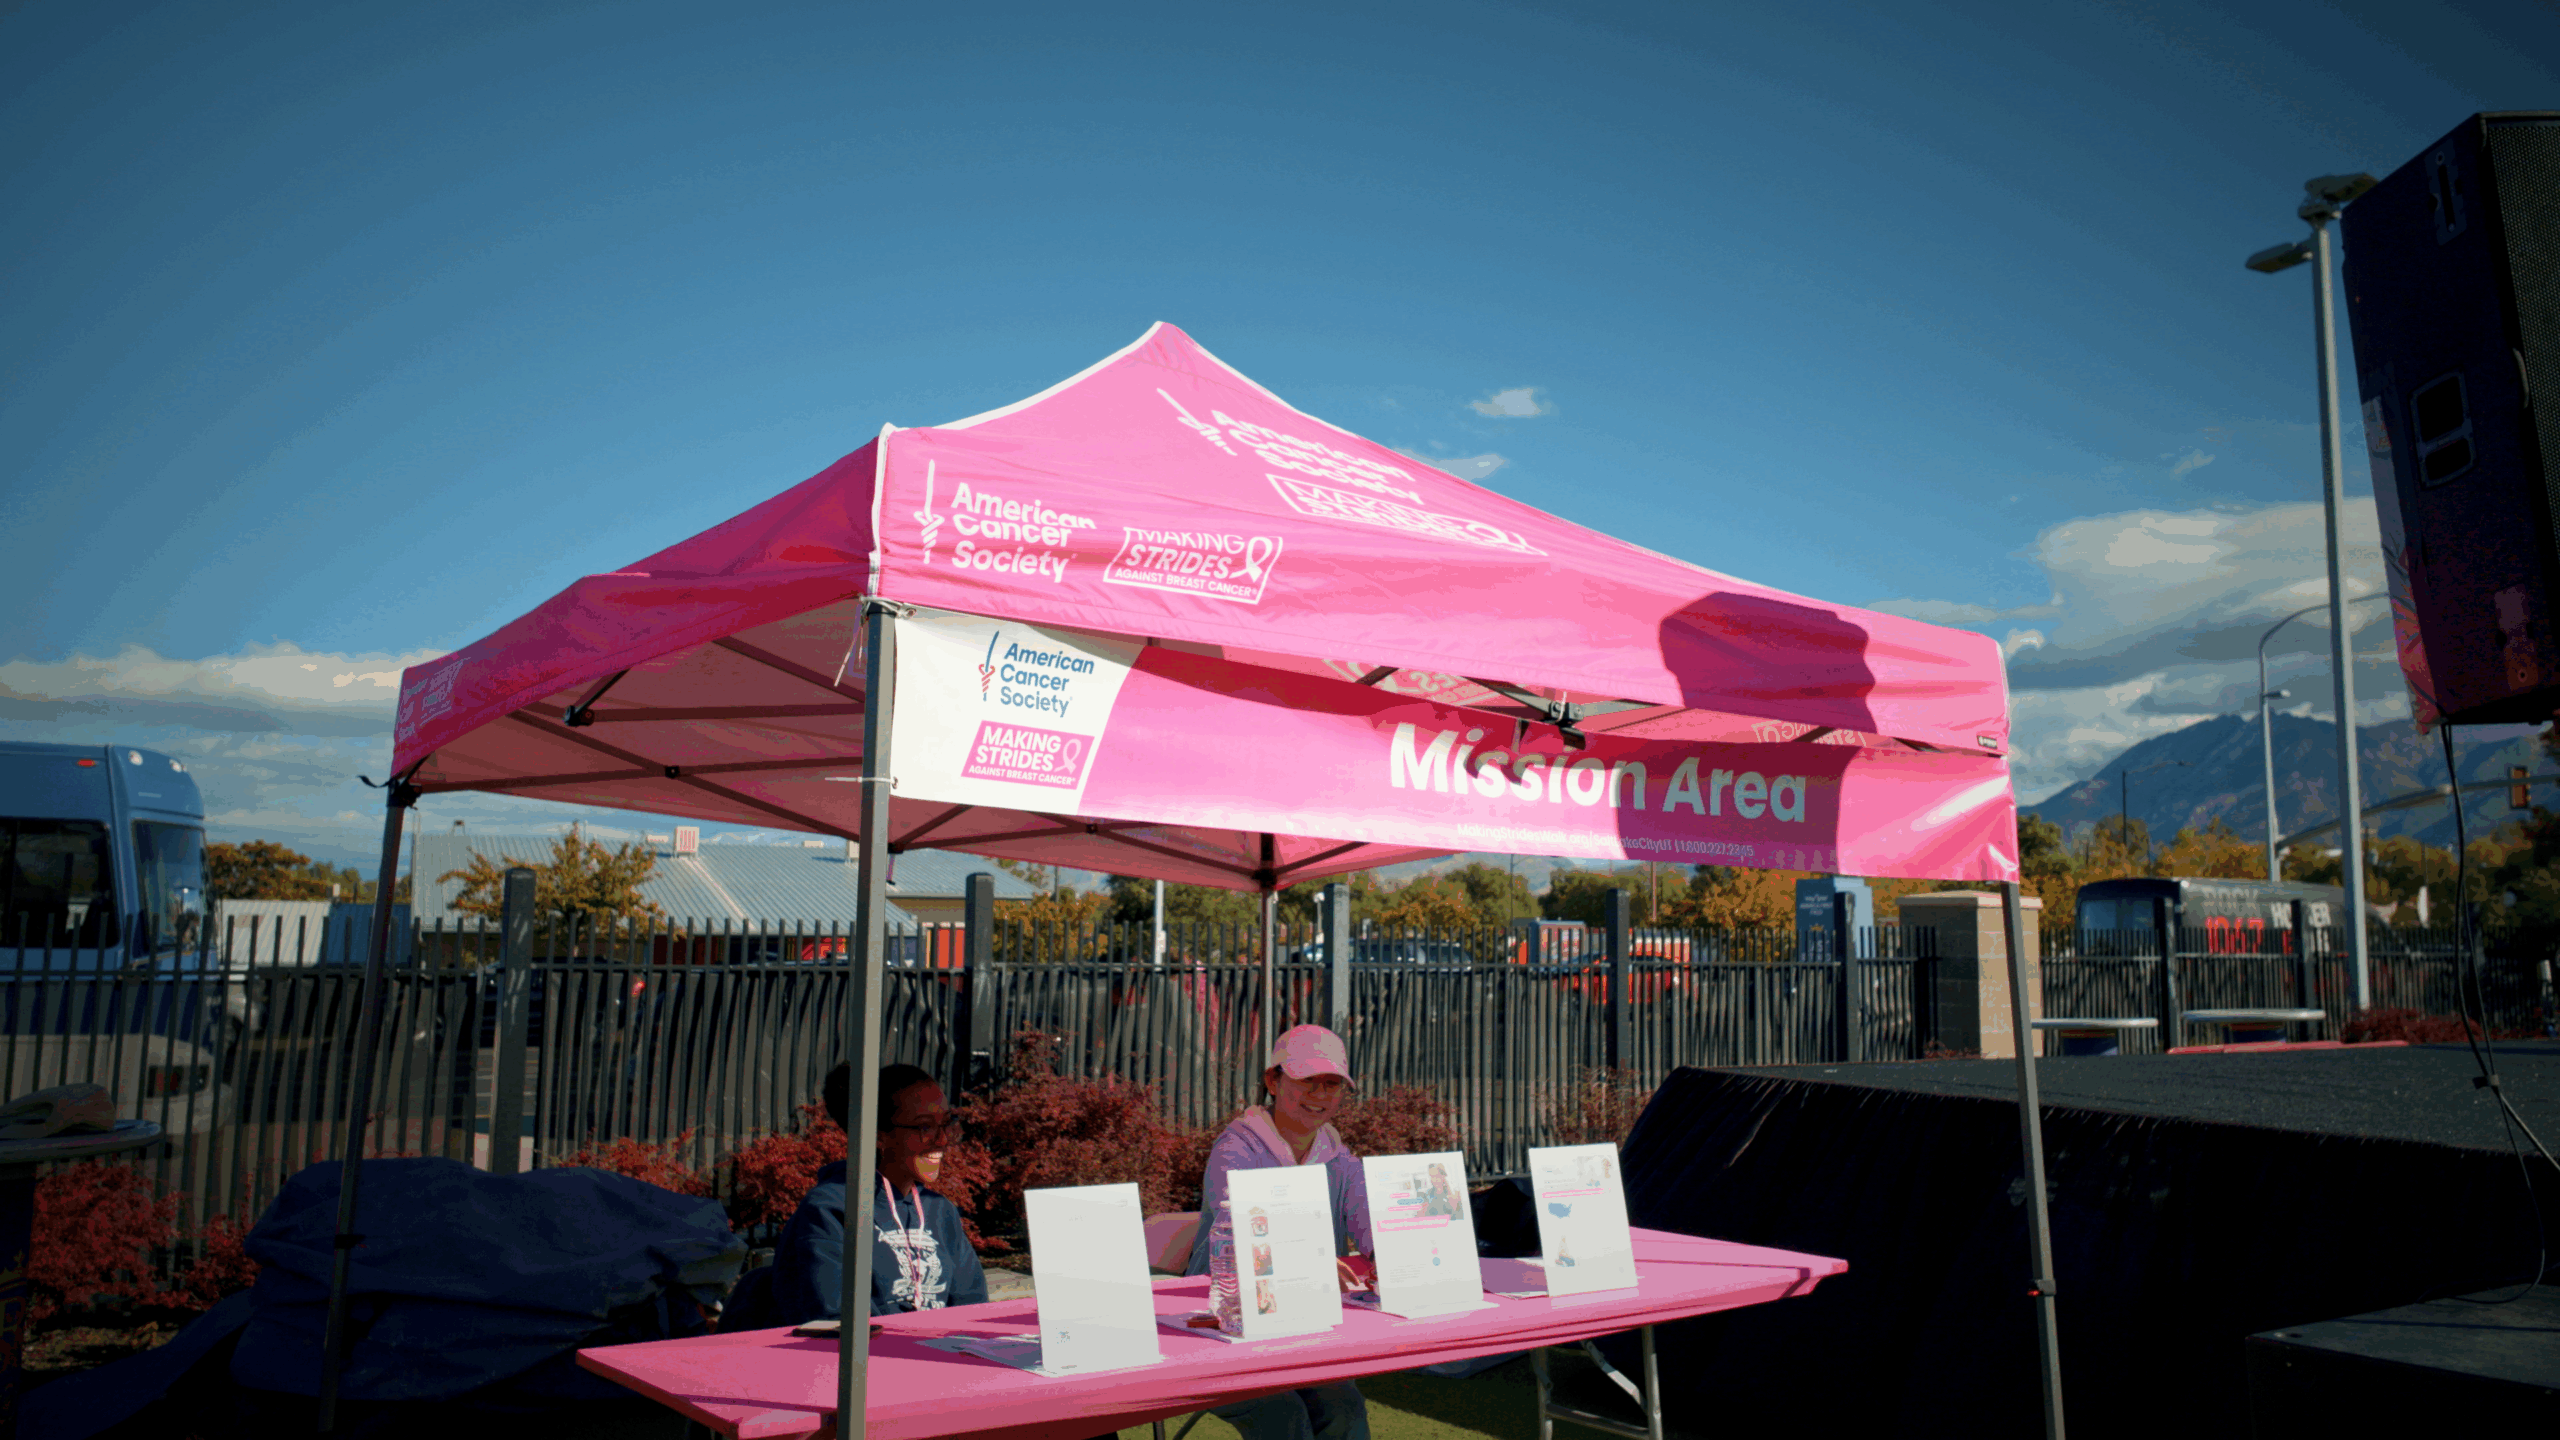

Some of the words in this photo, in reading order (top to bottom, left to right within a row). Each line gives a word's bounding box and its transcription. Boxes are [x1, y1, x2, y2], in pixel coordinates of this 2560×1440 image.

[951, 482, 1097, 530] American
[952, 514, 1072, 548] Cancer
[1137, 530, 1246, 555] MAKING
[951, 540, 1069, 583] Society
[1126, 544, 1232, 579] STRIDES
[1115, 568, 1164, 584] AGAINST
[1166, 575, 1206, 589] BREAST
[1003, 642, 1095, 675] American
[1000, 663, 1069, 692] Cancer
[1000, 686, 1069, 718] Society
[982, 725, 1062, 754] MAKING
[969, 765, 1006, 778] AGAINST
[1006, 769, 1037, 782] BREAST
[976, 745, 1055, 772] STRIDES
[1391, 722, 1646, 810] Mission
[1662, 756, 1806, 823] Area
